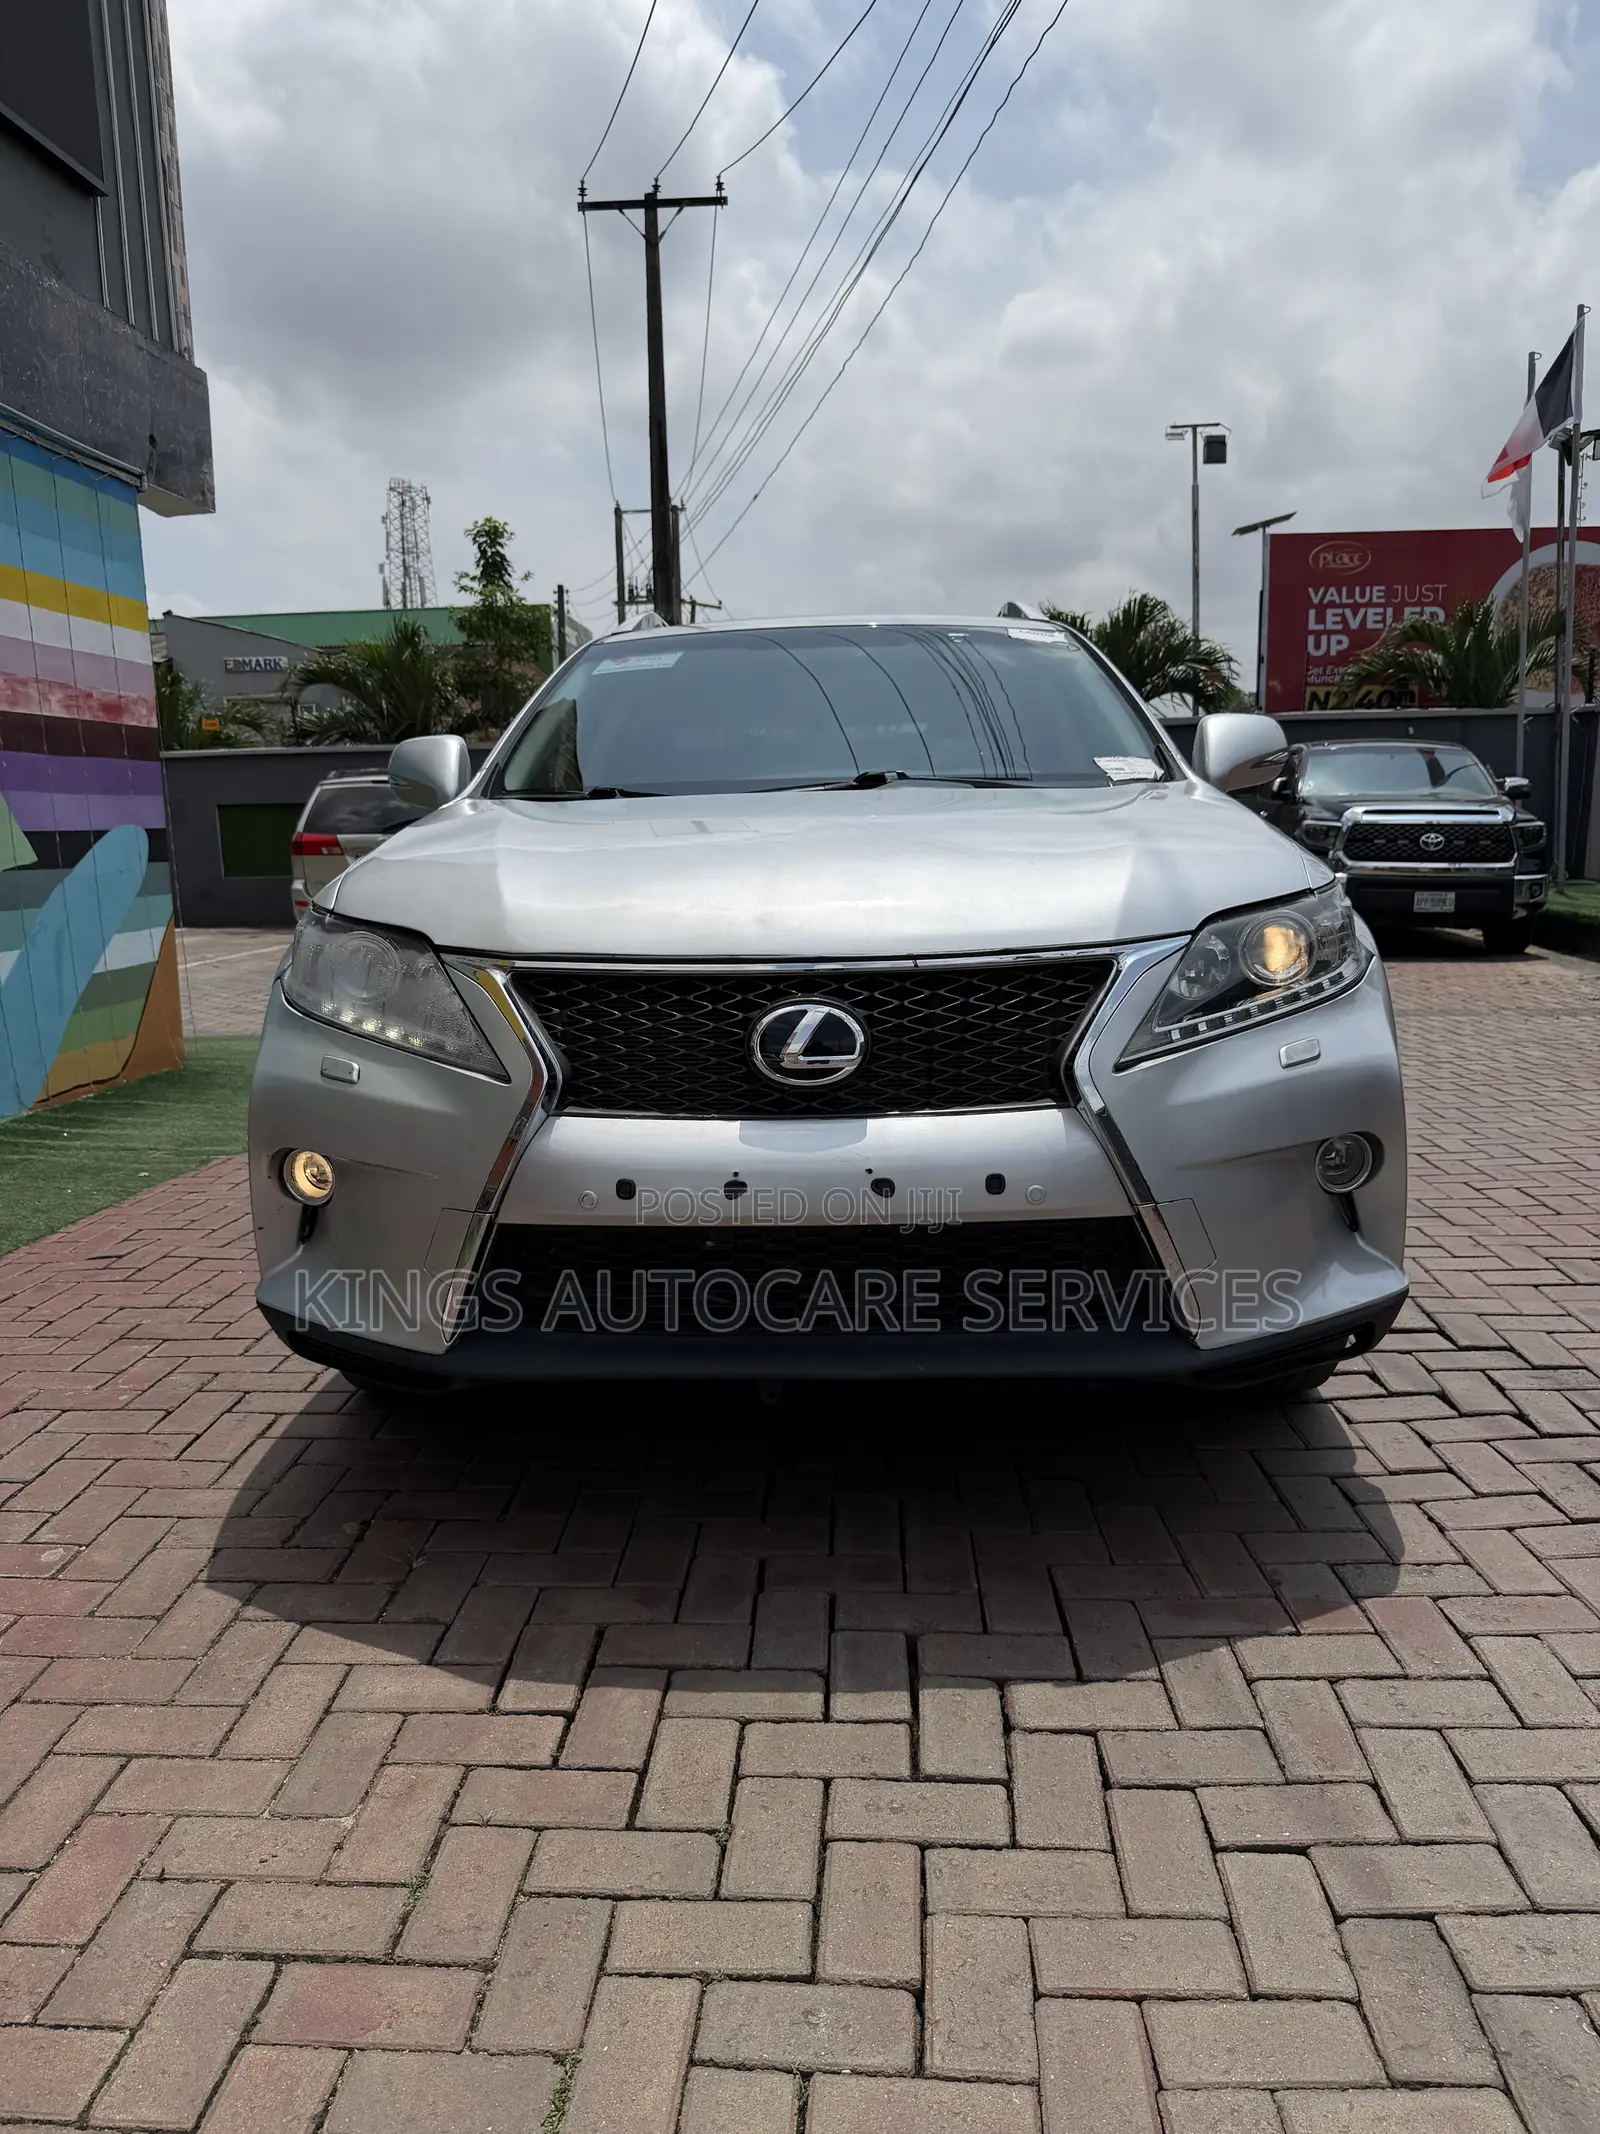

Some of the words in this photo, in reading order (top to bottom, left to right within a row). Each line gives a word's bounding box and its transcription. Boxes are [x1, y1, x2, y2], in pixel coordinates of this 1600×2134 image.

[1308, 586, 1386, 605] VALUE
[1392, 584, 1448, 603] JUST
[1308, 634, 1350, 657] UP
